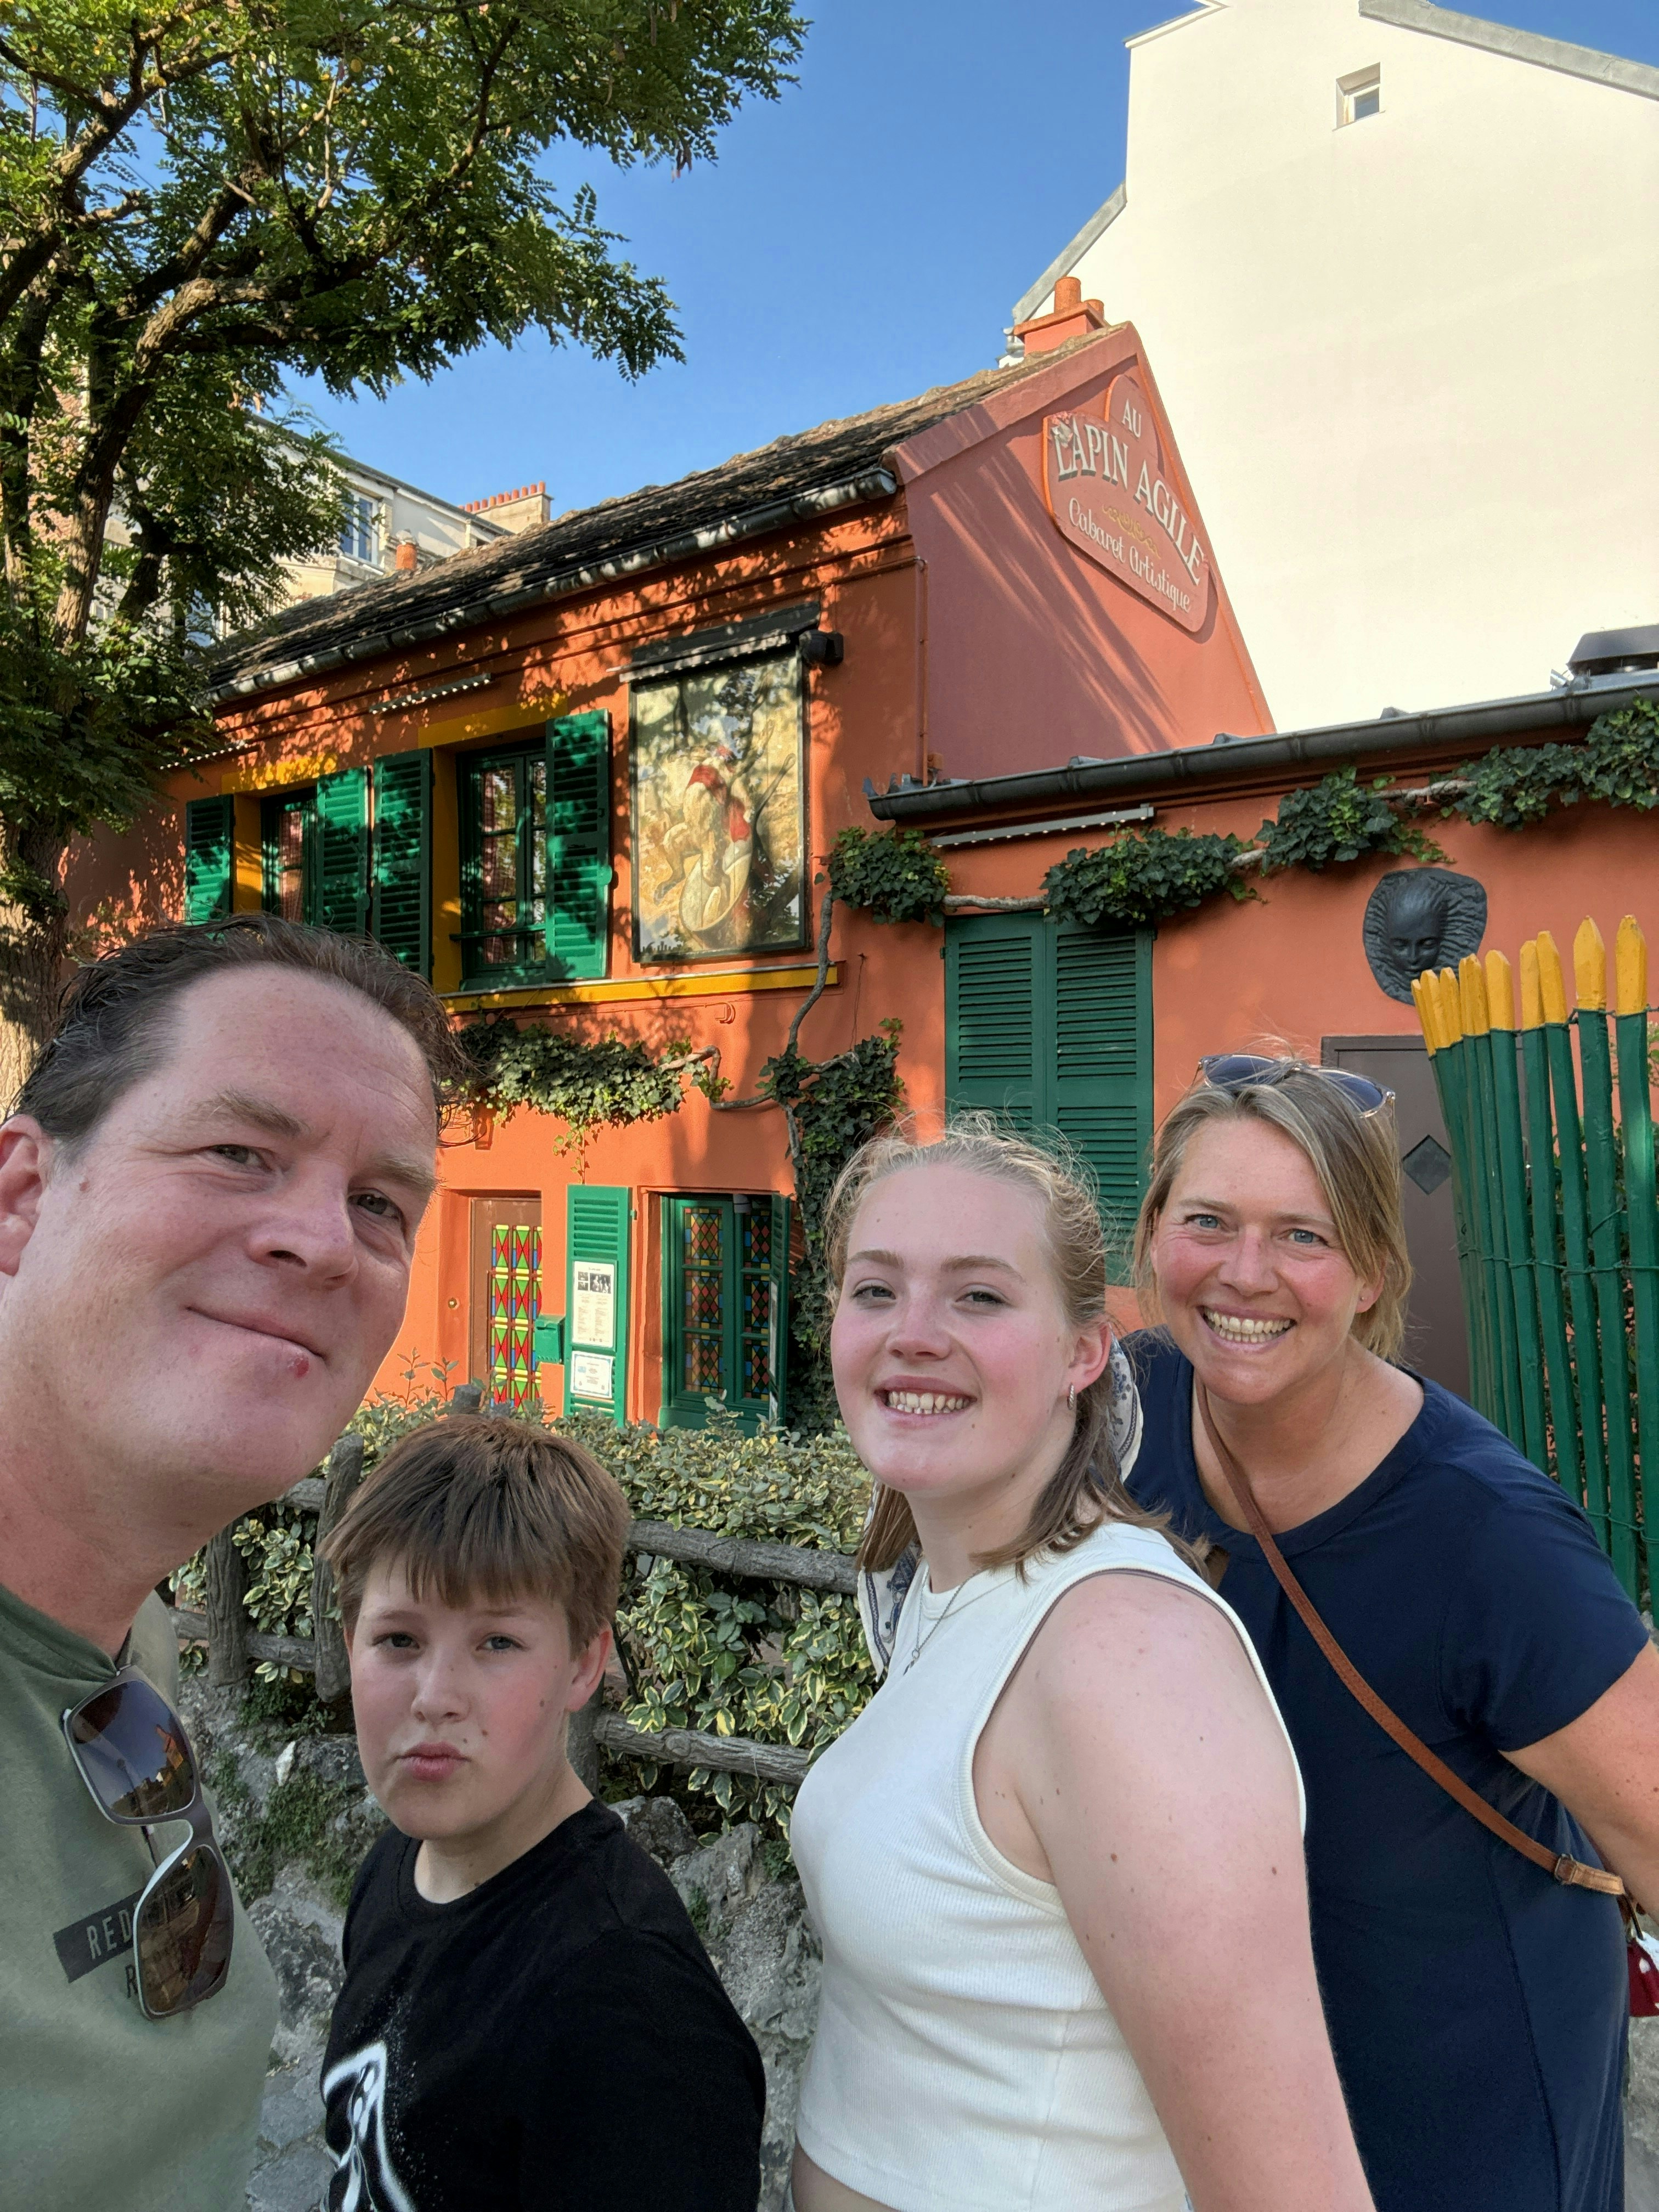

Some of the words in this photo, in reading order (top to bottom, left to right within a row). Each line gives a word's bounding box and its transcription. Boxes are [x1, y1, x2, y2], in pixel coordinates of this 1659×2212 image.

[1122, 399, 1142, 438] AU
[1050, 416, 1128, 492] LAPIN
[1133, 460, 1205, 586] AGILE
[1069, 497, 1126, 563] Cabaret
[1129, 544, 1191, 613] Artistique
[86, 1901, 138, 1960] RED
